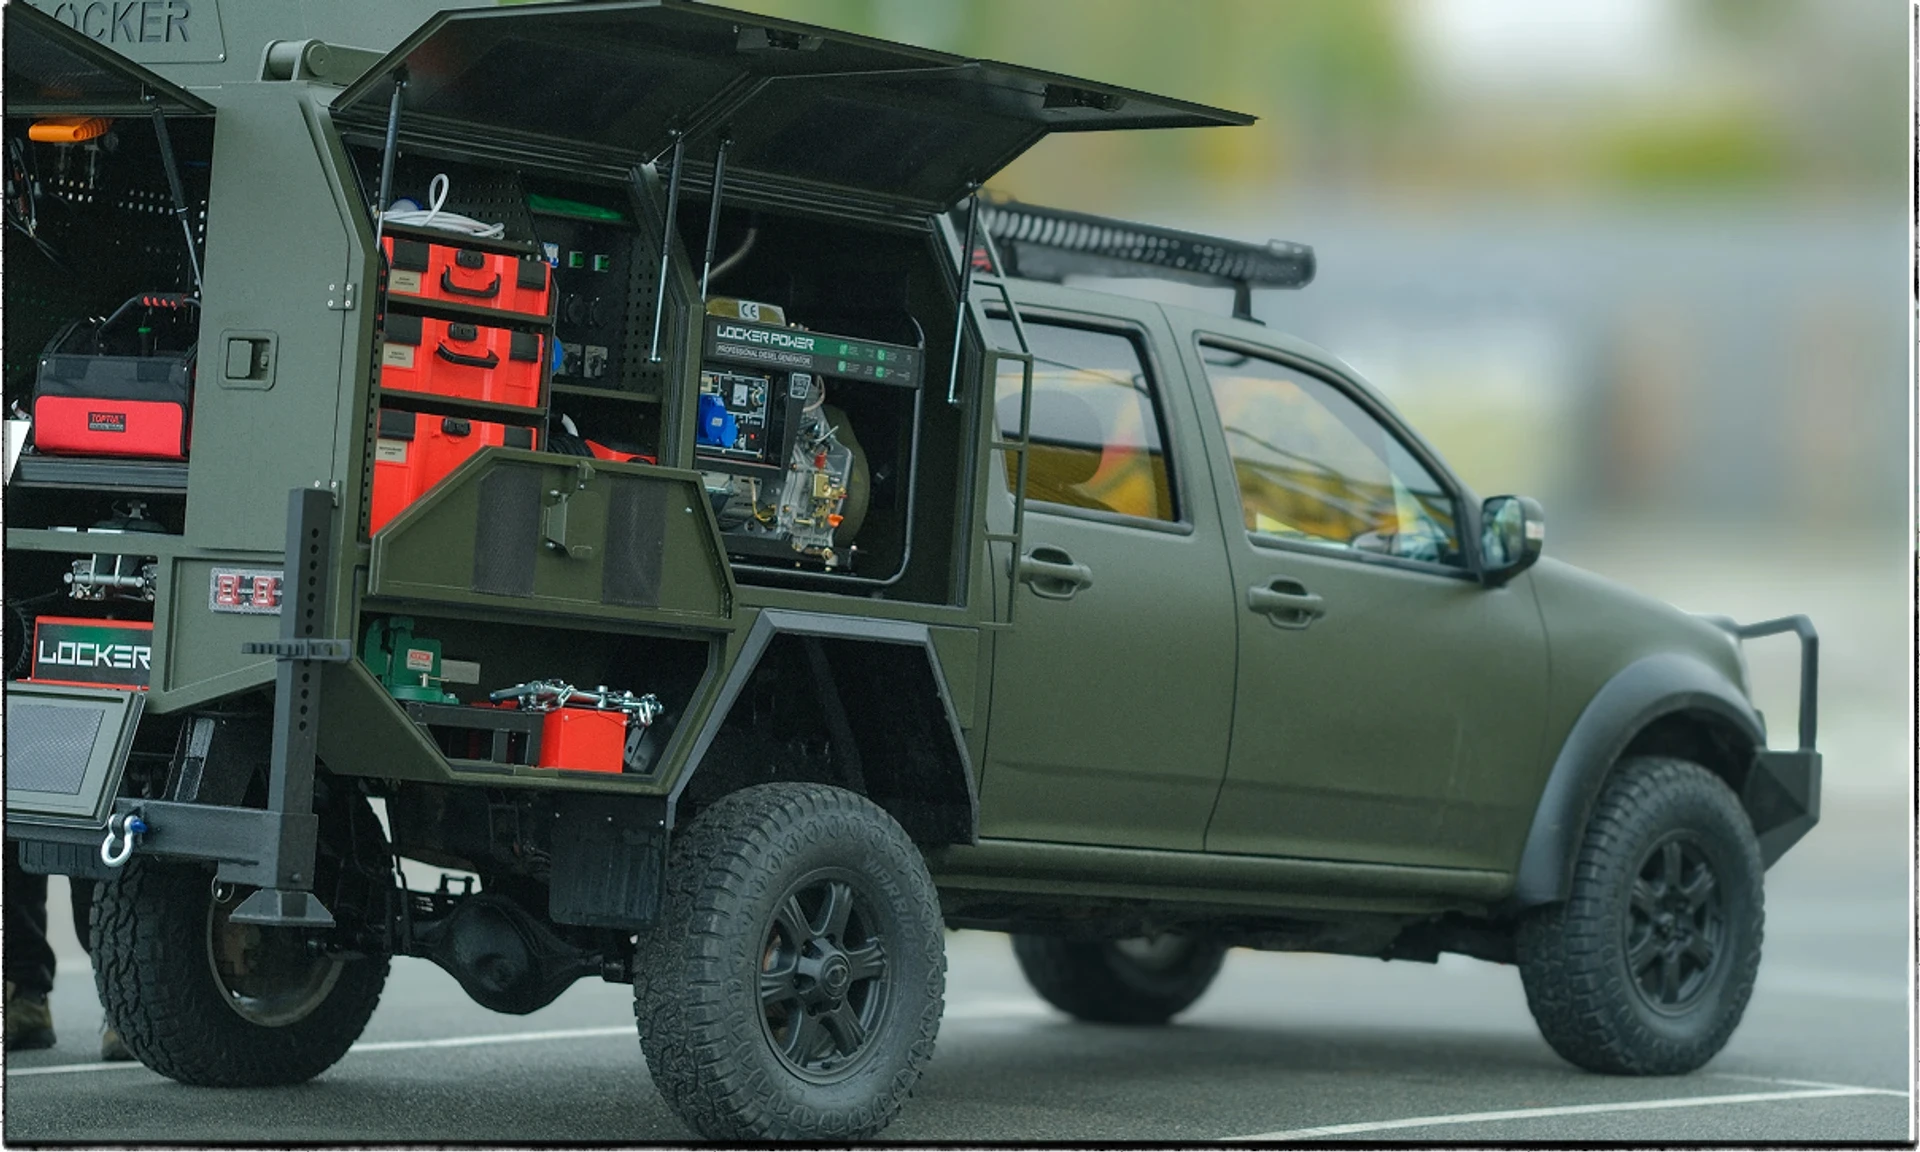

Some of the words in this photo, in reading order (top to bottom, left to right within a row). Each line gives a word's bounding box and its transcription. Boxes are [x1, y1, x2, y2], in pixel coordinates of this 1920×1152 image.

[32, 1, 191, 42] OCKER
[741, 301, 757, 319] CE
[717, 325, 769, 345] LOCKER
[770, 333, 815, 352] POWER
[717, 344, 758, 358] PROFESSIONAL
[758, 351, 777, 361] DIESEL
[778, 355, 811, 366] GENERATOR
[38, 640, 150, 669] LOCKER
